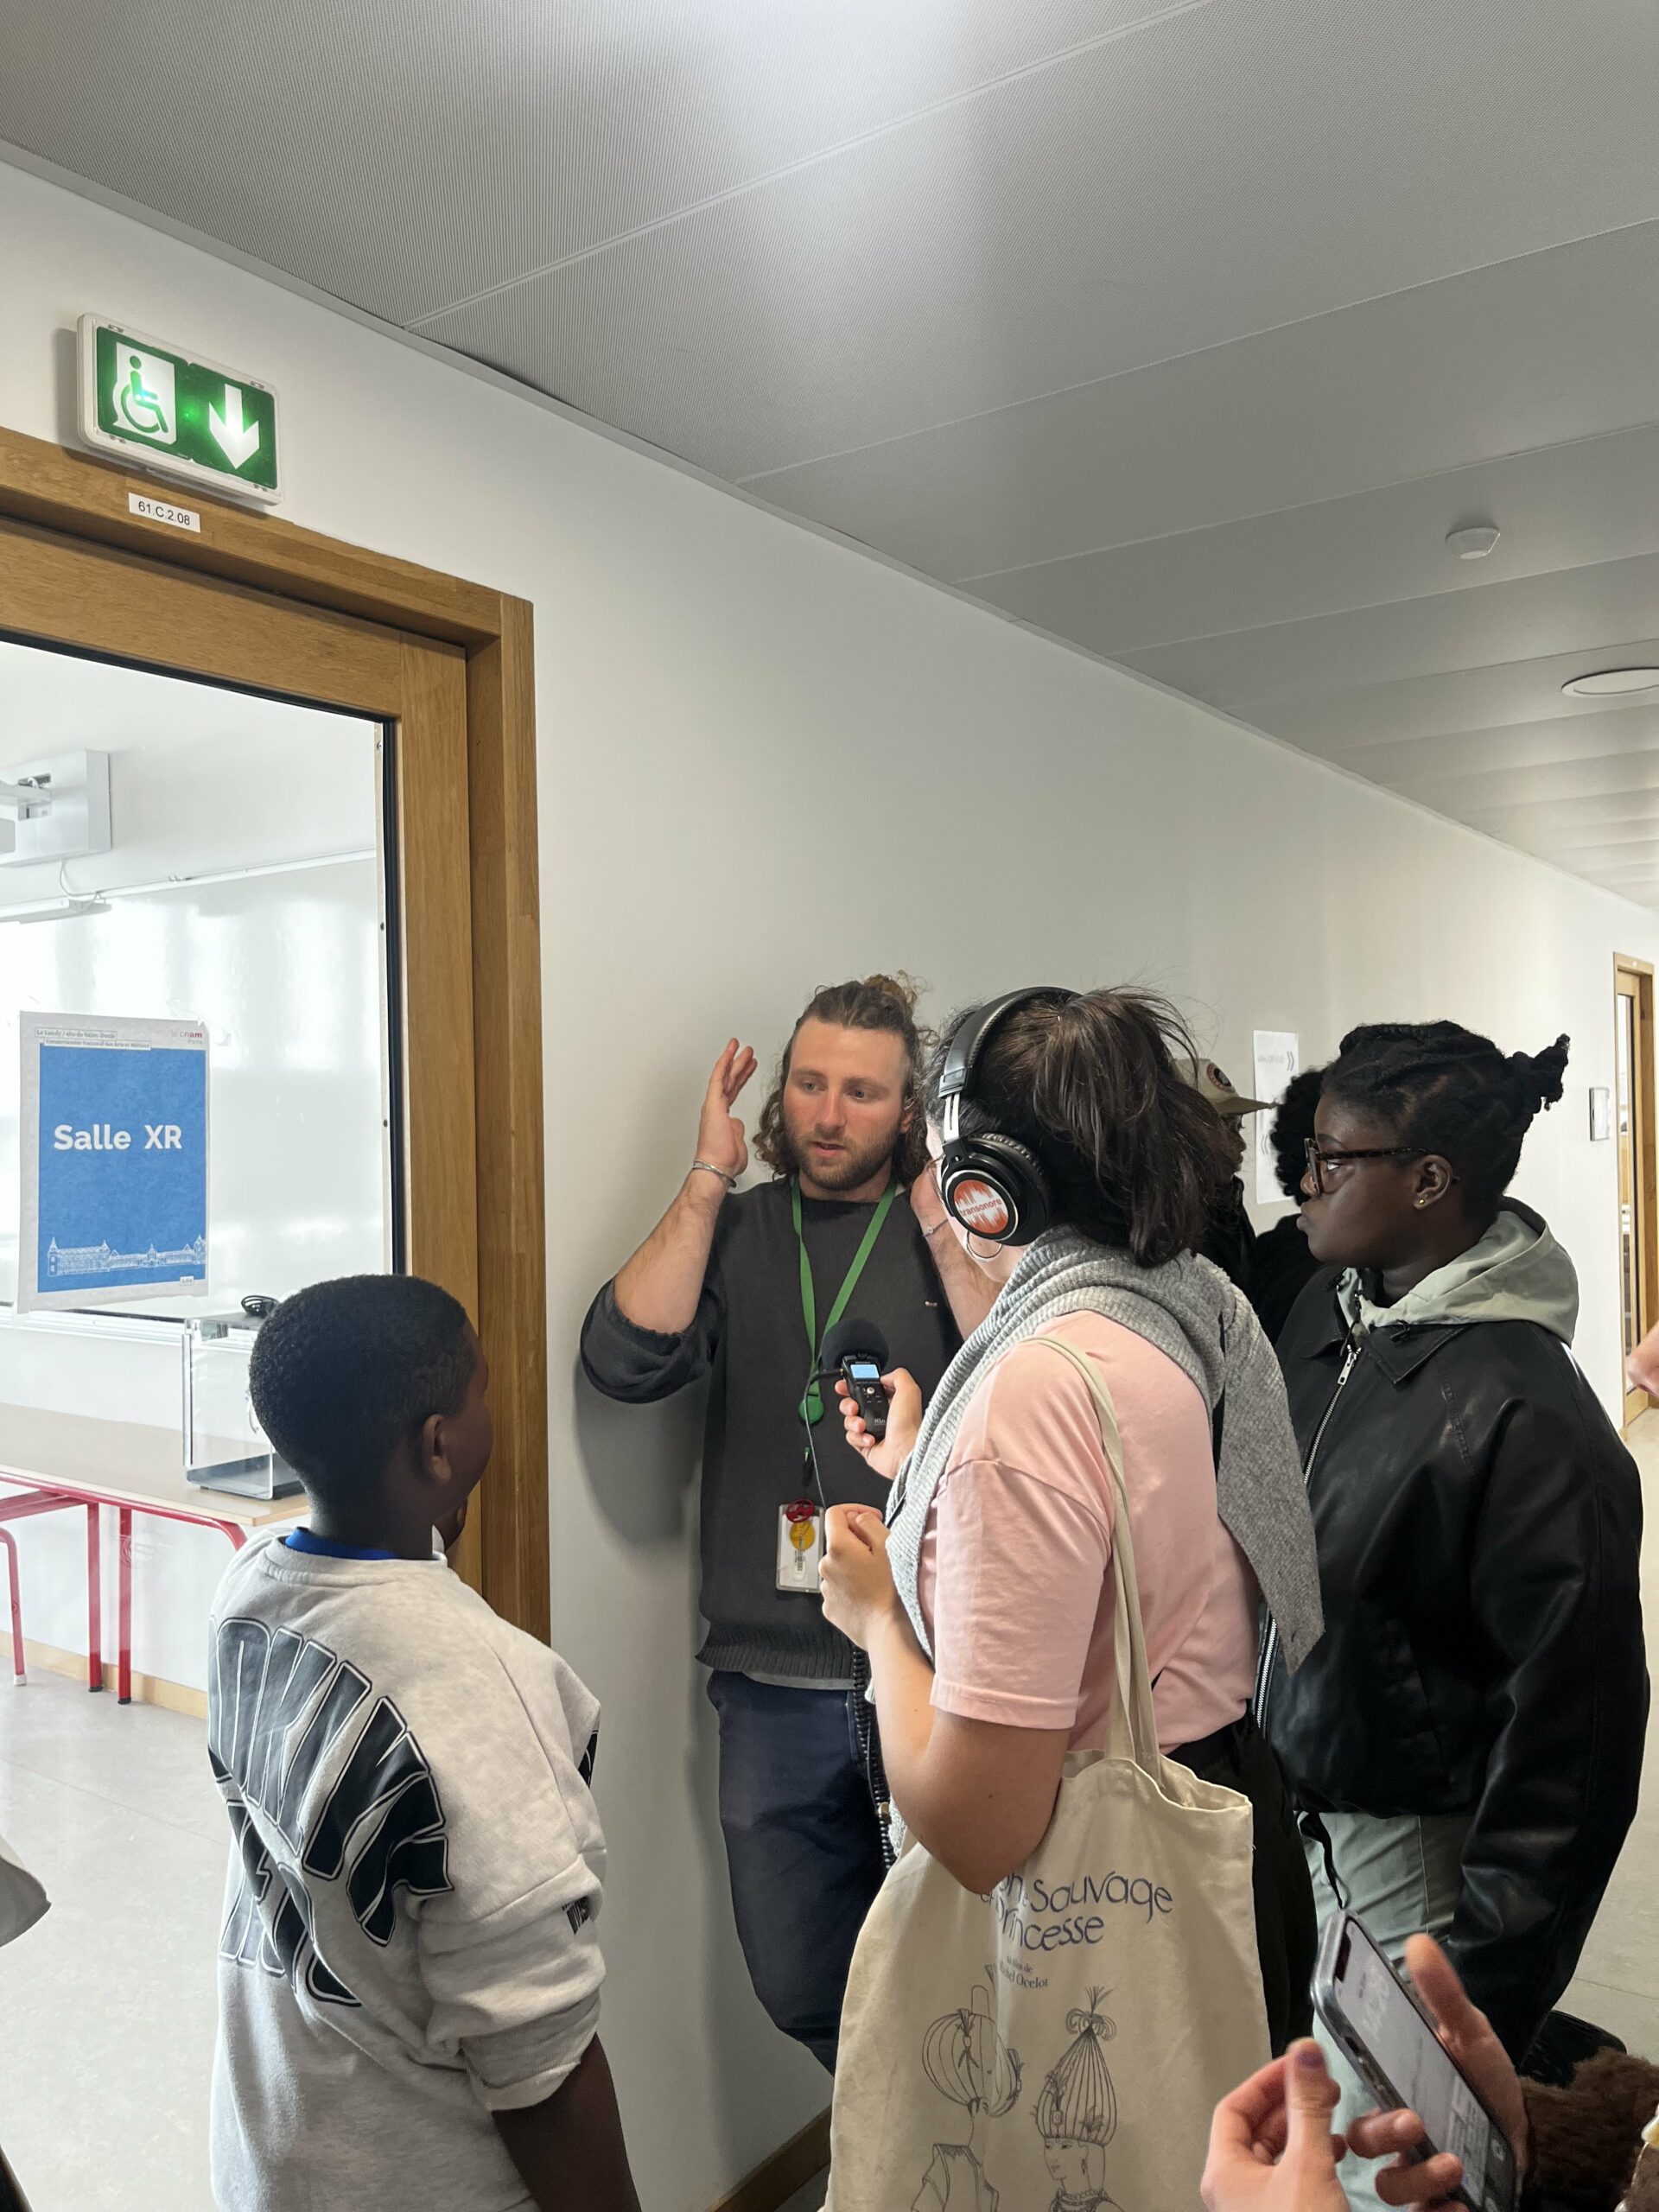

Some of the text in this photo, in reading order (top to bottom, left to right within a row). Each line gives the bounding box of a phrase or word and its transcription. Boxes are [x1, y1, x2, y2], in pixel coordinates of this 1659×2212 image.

[138, 501, 190, 526] 61.C.2.08
[54, 1124, 182, 1151] Salle XR
[960, 1198, 1002, 1217] transonore
[1030, 1871, 1173, 1924] Sauvage
[1016, 1973, 1048, 1988] Ocelot
